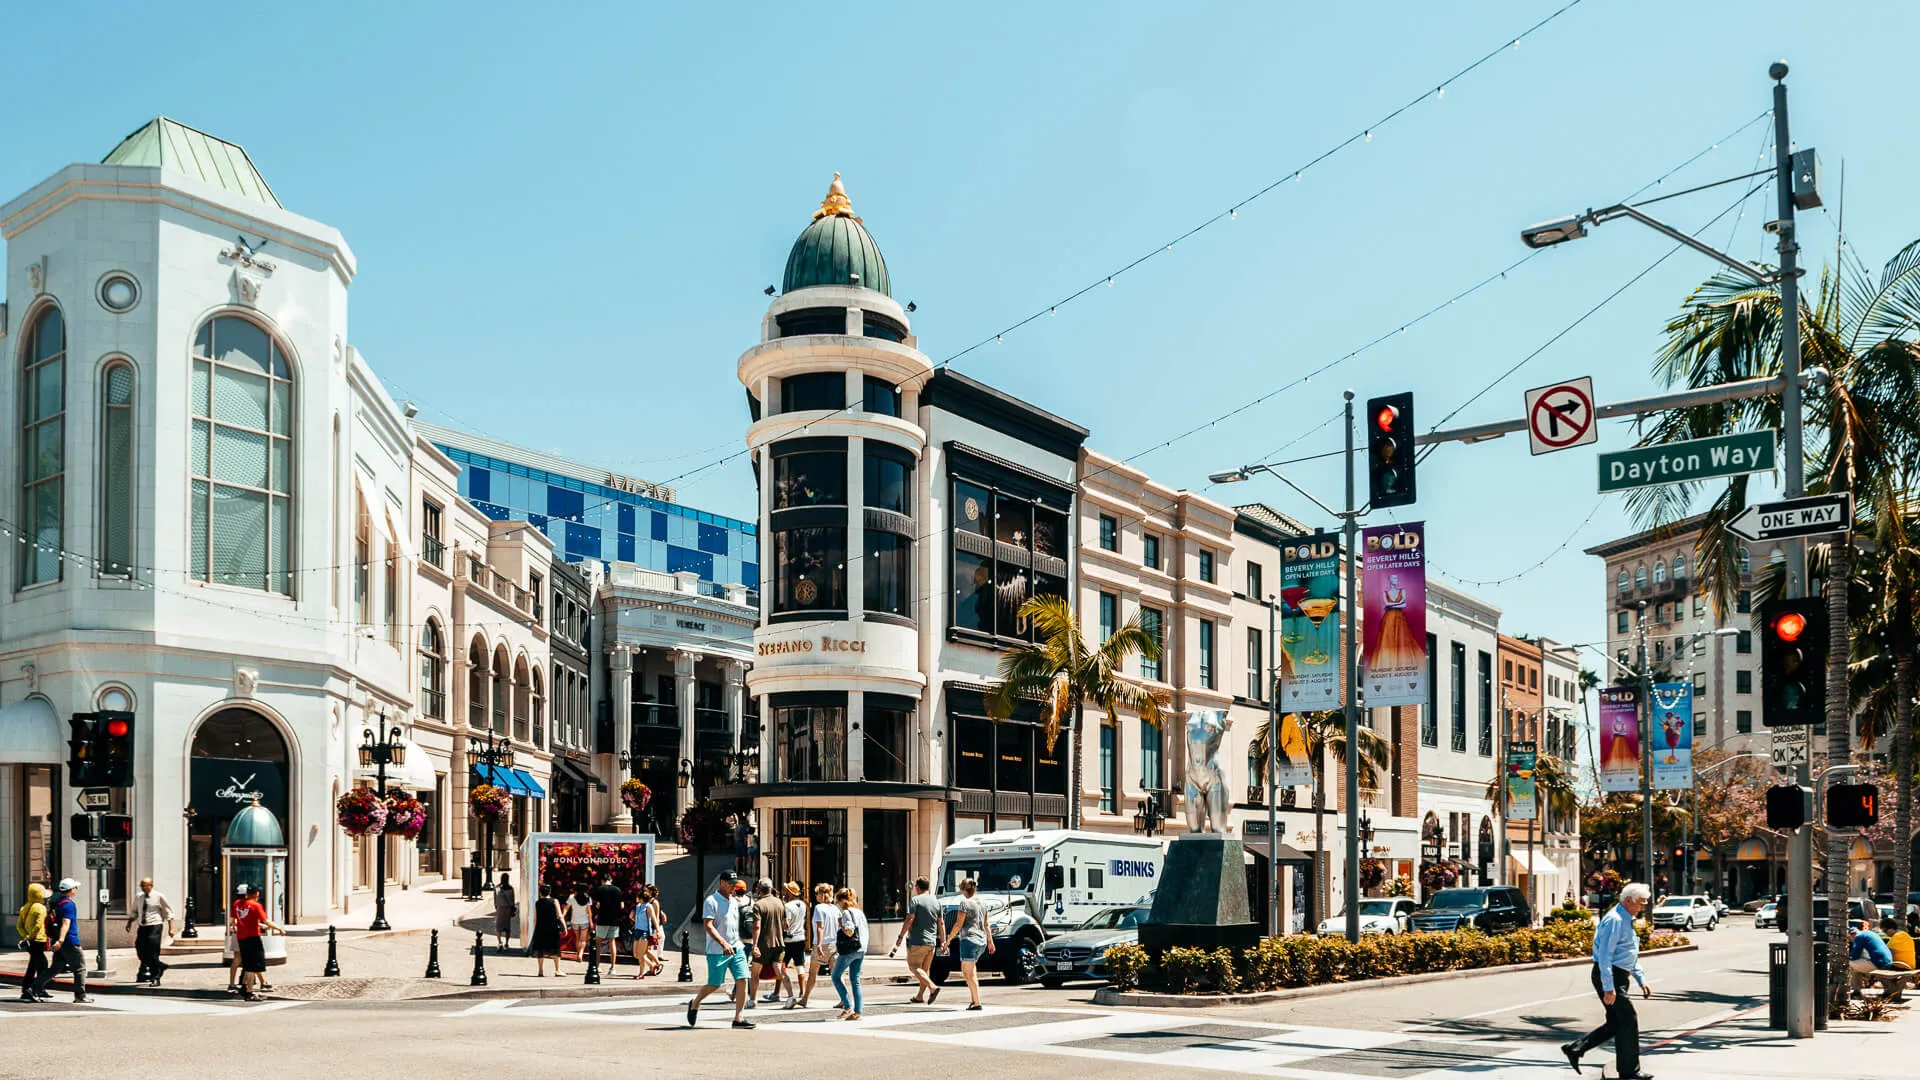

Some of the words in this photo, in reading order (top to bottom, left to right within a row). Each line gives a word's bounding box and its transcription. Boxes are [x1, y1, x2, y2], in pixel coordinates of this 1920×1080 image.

[1610, 454, 1700, 482] Dayton
[1710, 445, 1762, 467] Way
[610, 472, 677, 504] MGM
[1761, 512, 1795, 528] ONE
[1801, 507, 1835, 523] WAY
[1284, 542, 1335, 562] BOLD
[1367, 532, 1420, 553] BOLD
[1285, 564, 1315, 573] BEVERLY
[1316, 561, 1335, 569] HILLS
[1367, 554, 1397, 563] BEVERLY
[1400, 552, 1420, 560] HILLS
[758, 640, 813, 657] STEFANO
[821, 636, 865, 653] RICCI
[1773, 733, 1805, 743] CROSSING
[1773, 749, 1786, 762] OK
[87, 795, 97, 804] ONE
[98, 795, 107, 804] WAY
[1862, 795, 1873, 816] 4
[122, 821, 131, 836] 4
[553, 856, 629, 864] #ONLYONRODEO
[1115, 859, 1155, 878] BRINKS
